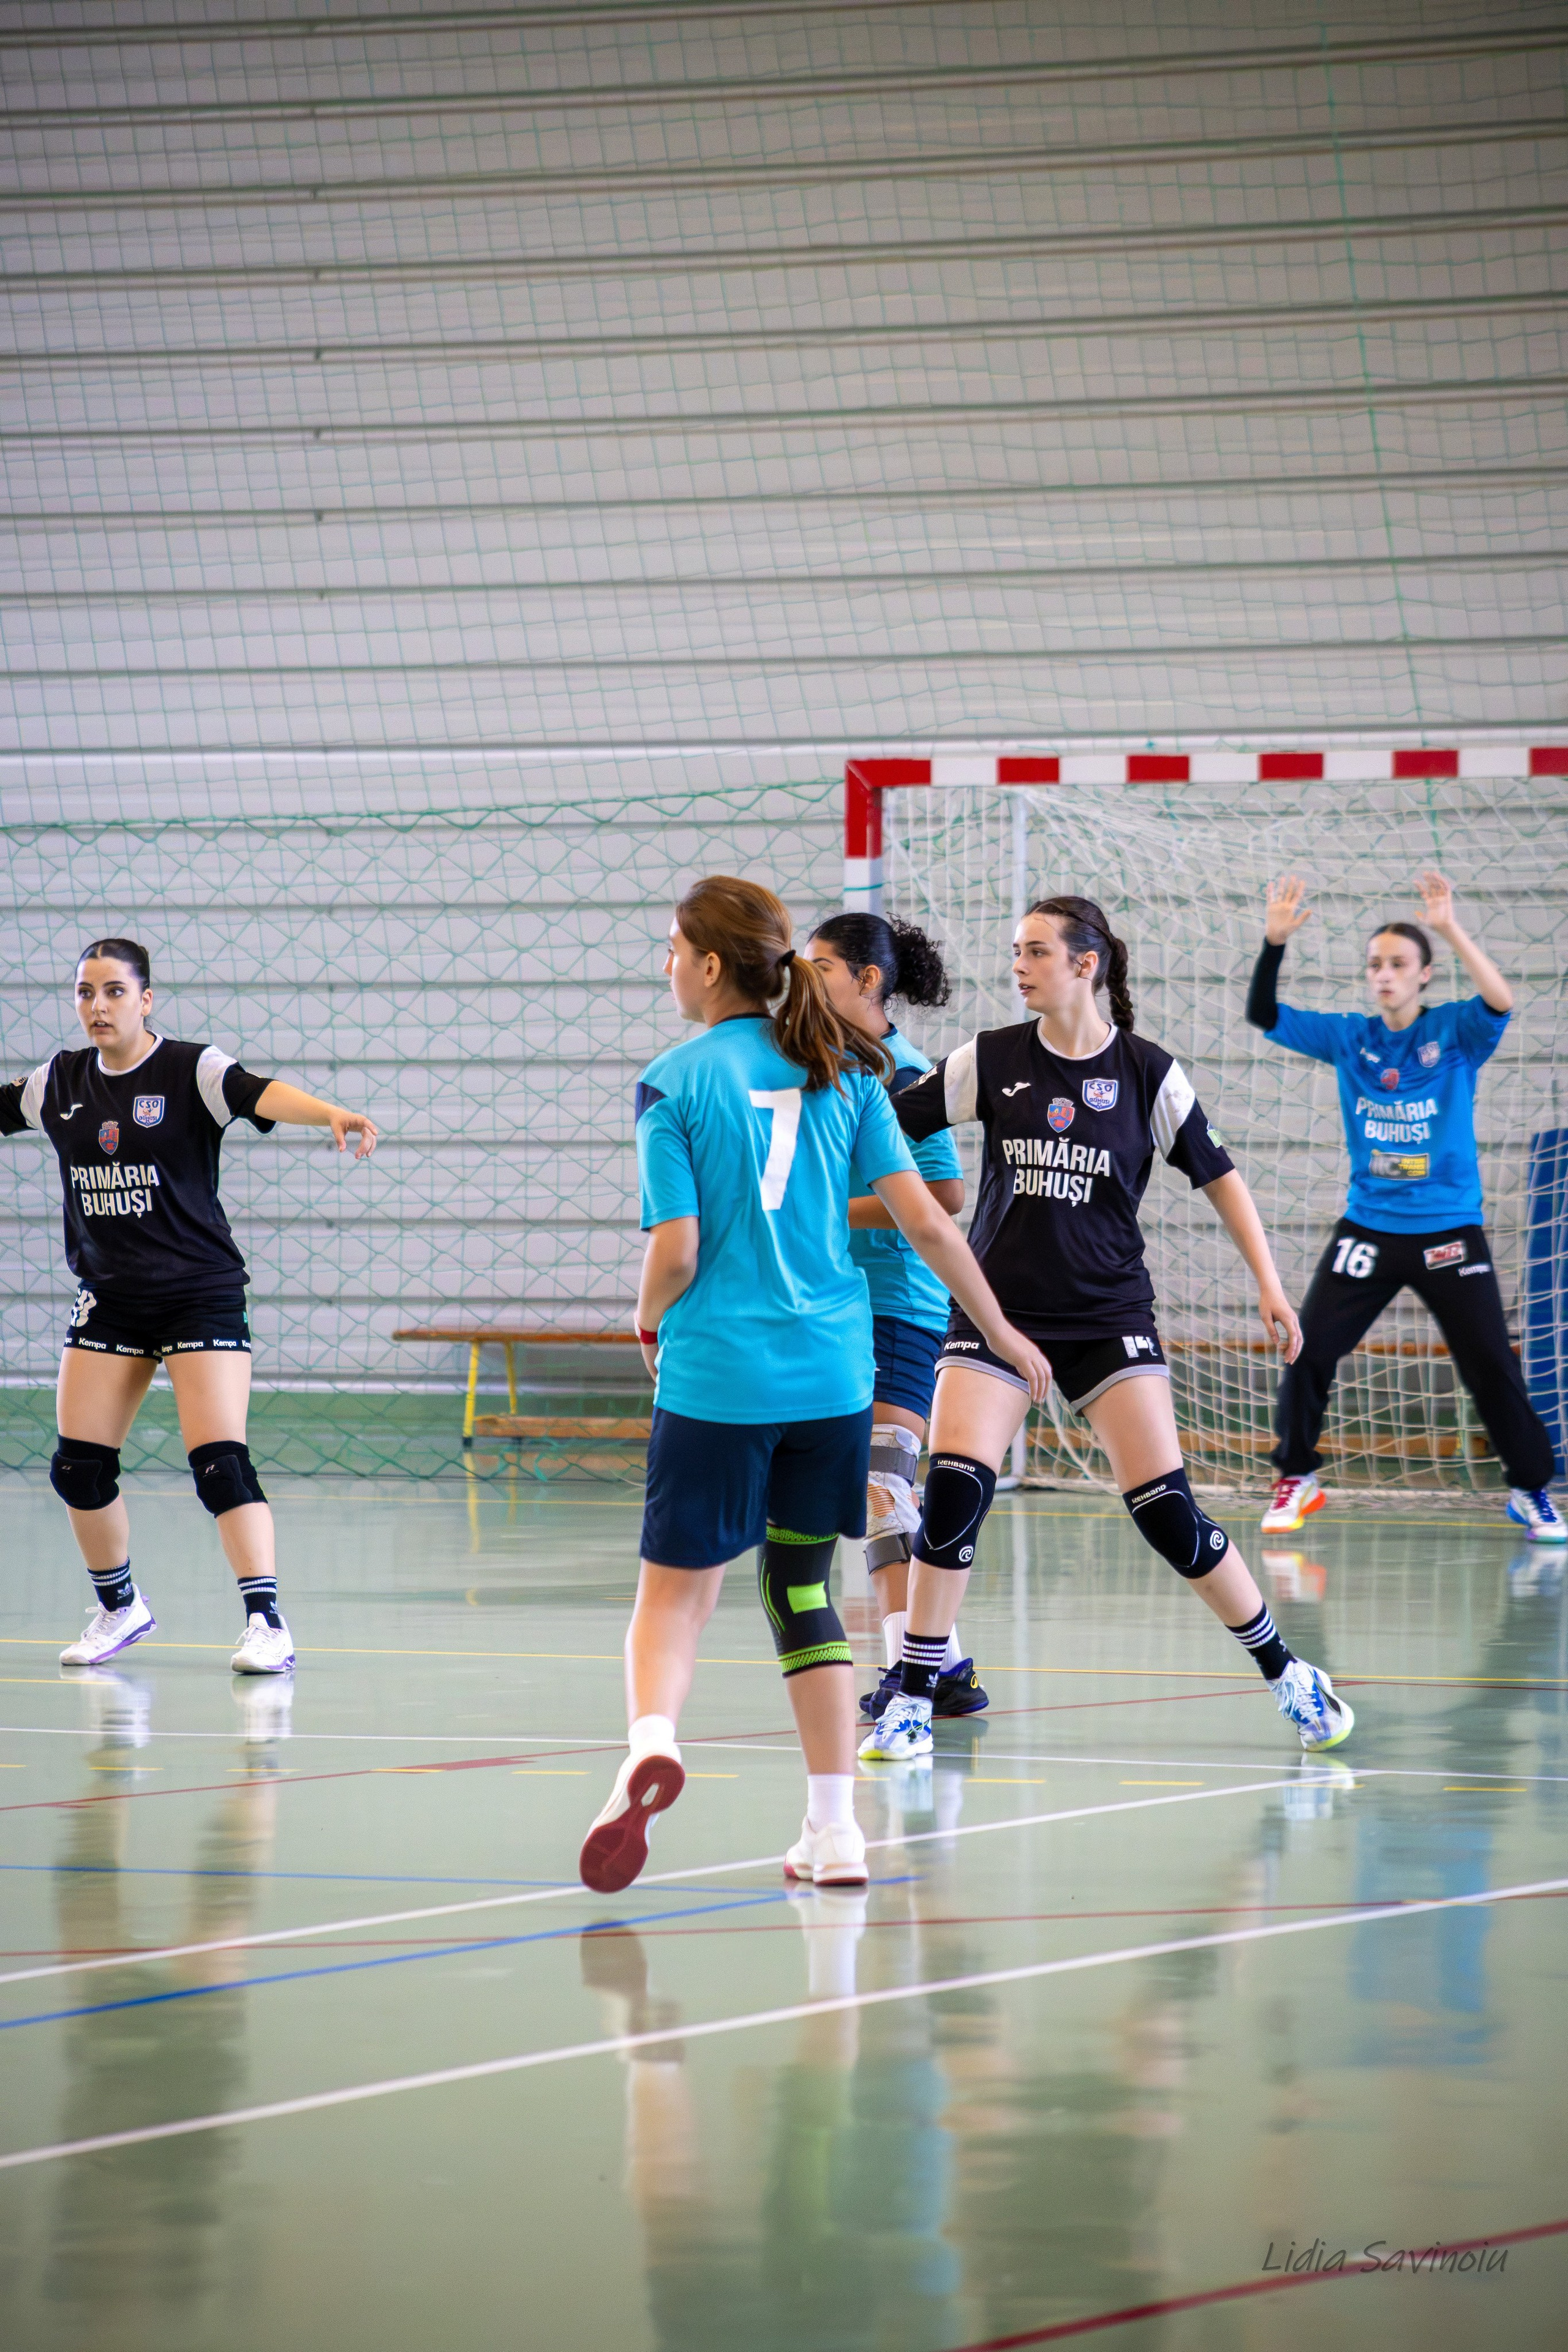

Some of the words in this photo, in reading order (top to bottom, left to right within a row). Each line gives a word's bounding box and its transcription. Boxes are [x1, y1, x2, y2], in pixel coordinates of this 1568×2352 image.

[1089, 1082, 1112, 1092] CSO
[139, 1100, 159, 1109] CSO
[1355, 1096, 1438, 1122] PRIMĂRIA
[1364, 1120, 1431, 1144] BUHUȘI
[748, 1088, 802, 1211] 7
[1002, 1137, 1110, 1177] PRIMĂRIA
[70, 1161, 160, 1190] PRIMĂRIA
[1013, 1168, 1093, 1207] BUHUȘI
[81, 1189, 153, 1218] BUHUȘI
[1332, 1237, 1379, 1279] 16
[78, 1338, 107, 1349] Kempa
[116, 1344, 144, 1355] Kempa
[213, 1340, 236, 1348] Kempa
[944, 1340, 979, 1350] Kempa
